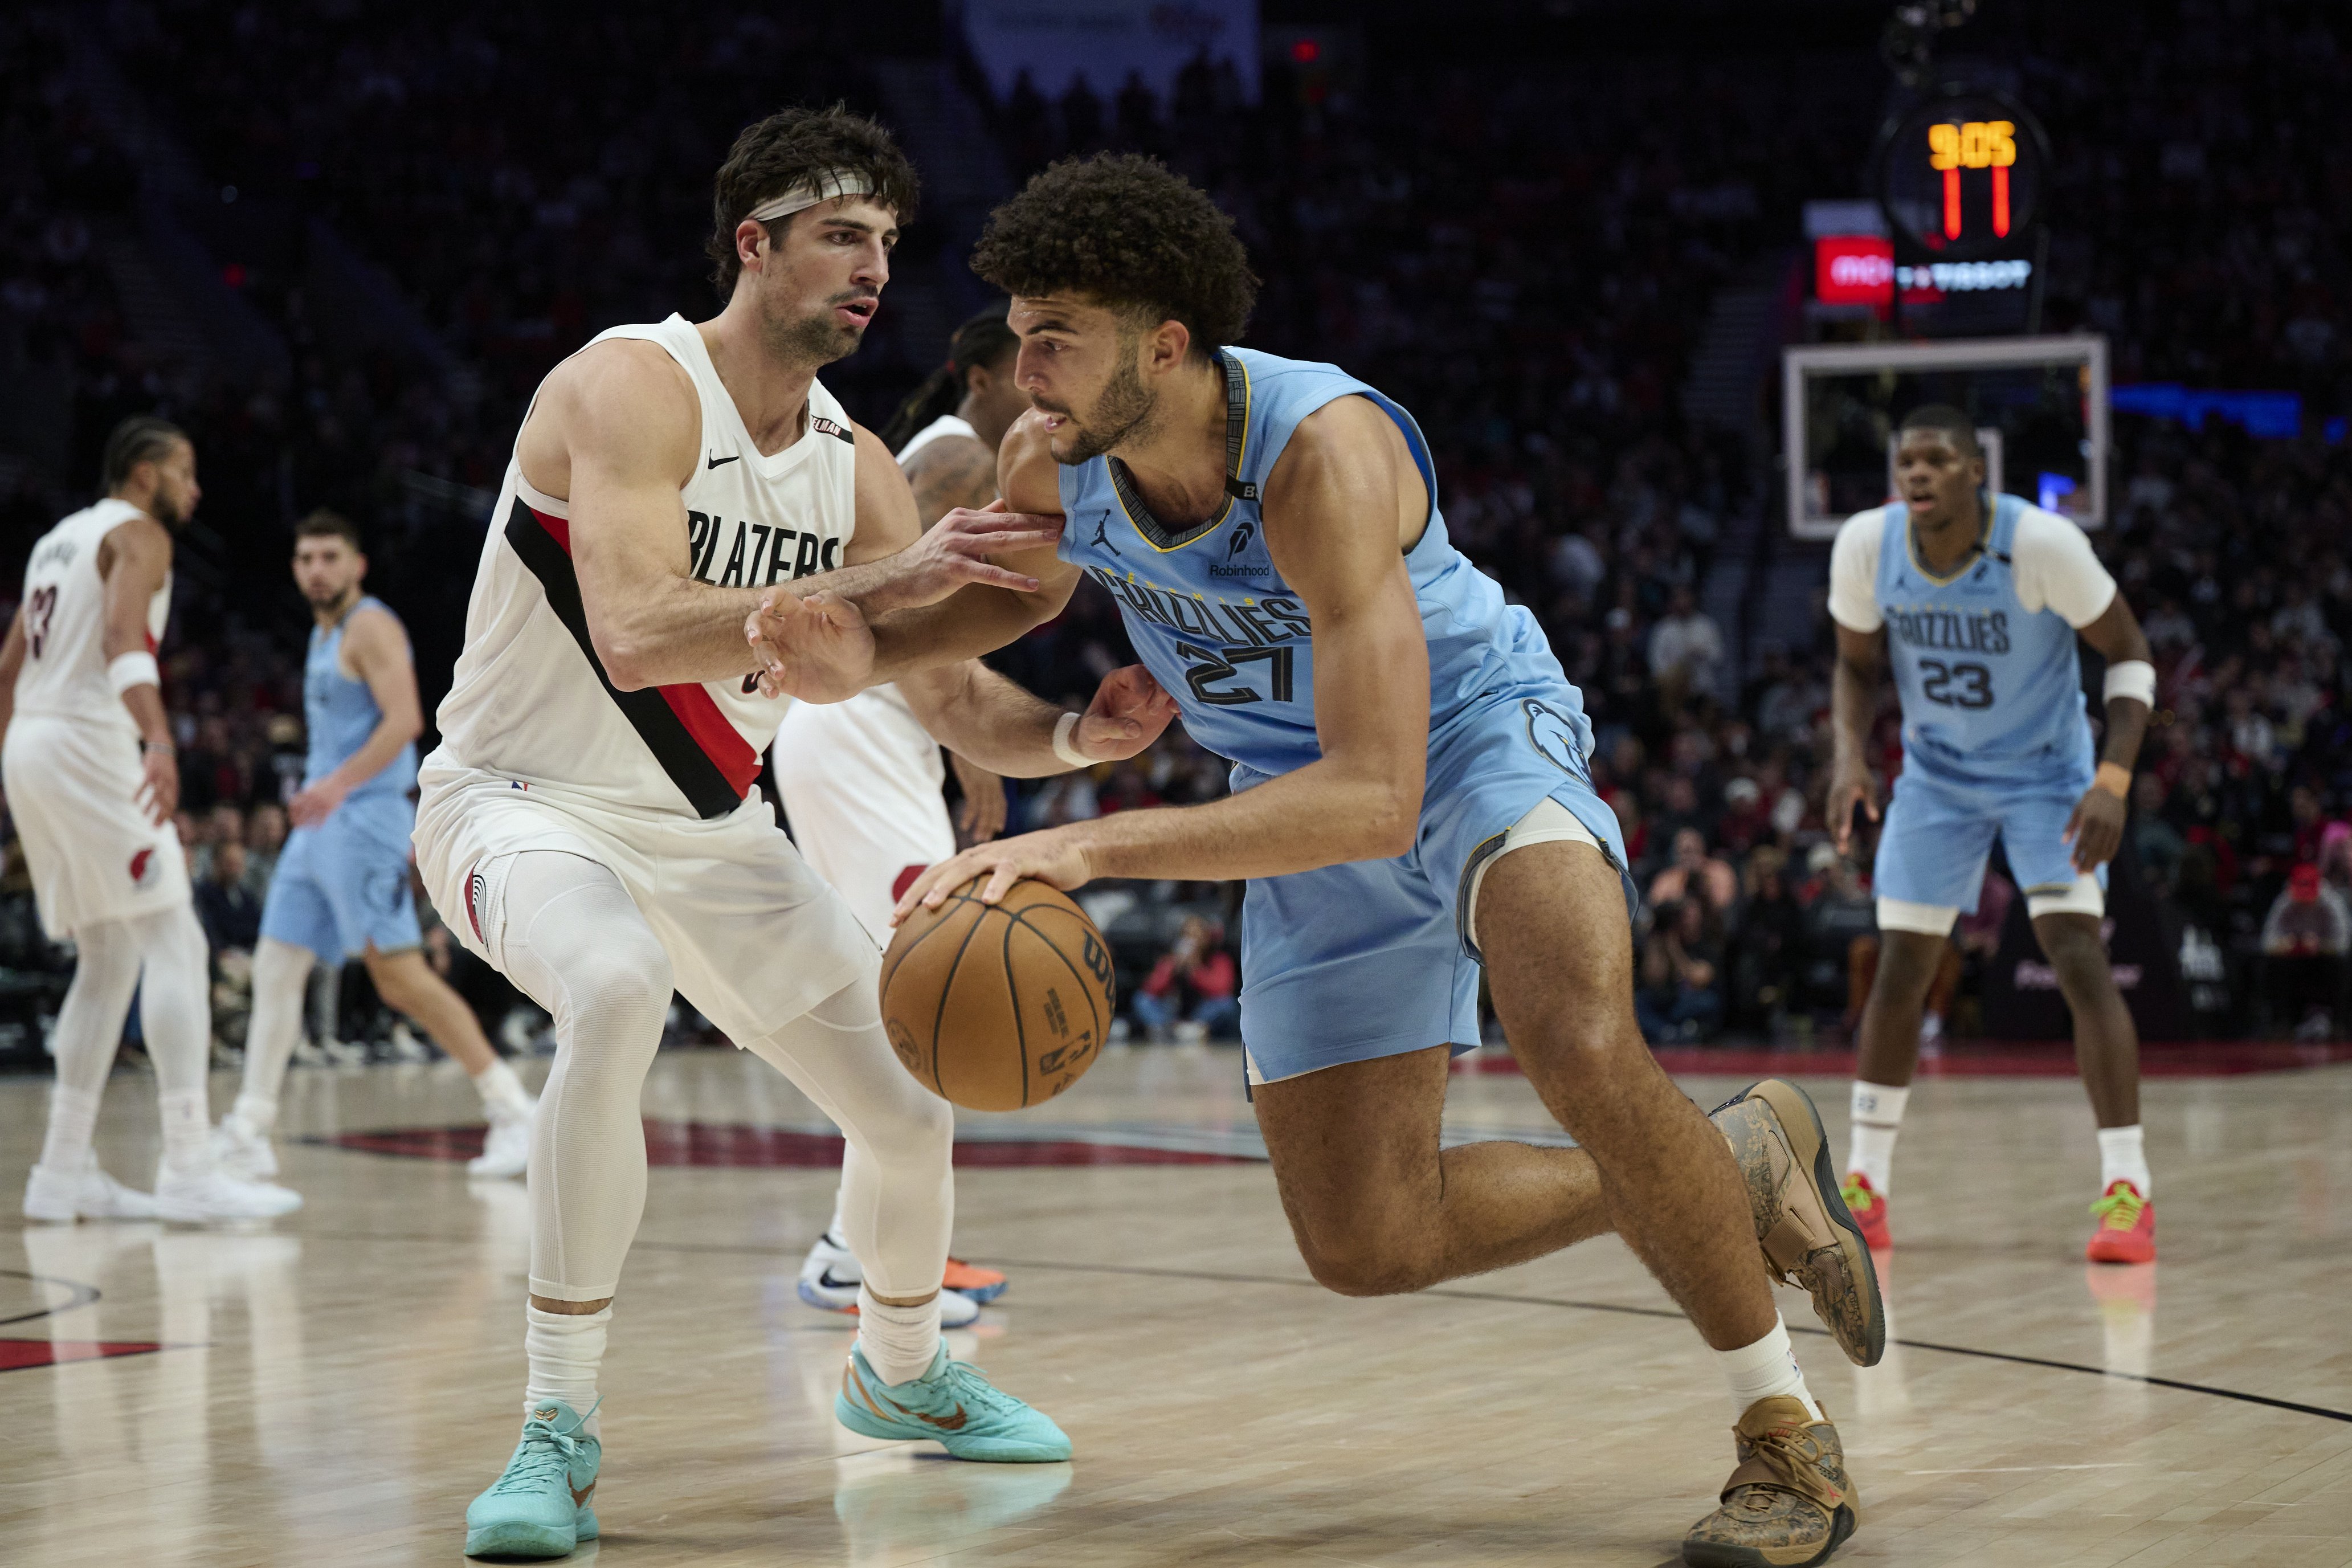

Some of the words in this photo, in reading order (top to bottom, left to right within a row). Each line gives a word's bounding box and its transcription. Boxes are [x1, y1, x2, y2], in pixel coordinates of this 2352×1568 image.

[1943, 166, 2010, 240] 11
[811, 416, 842, 436] ELMAN
[1210, 565, 1270, 577] Robinhood
[1089, 565, 1312, 646] GRIZZLIES
[1177, 640, 1293, 705] 27
[1918, 656, 1994, 708] 23
